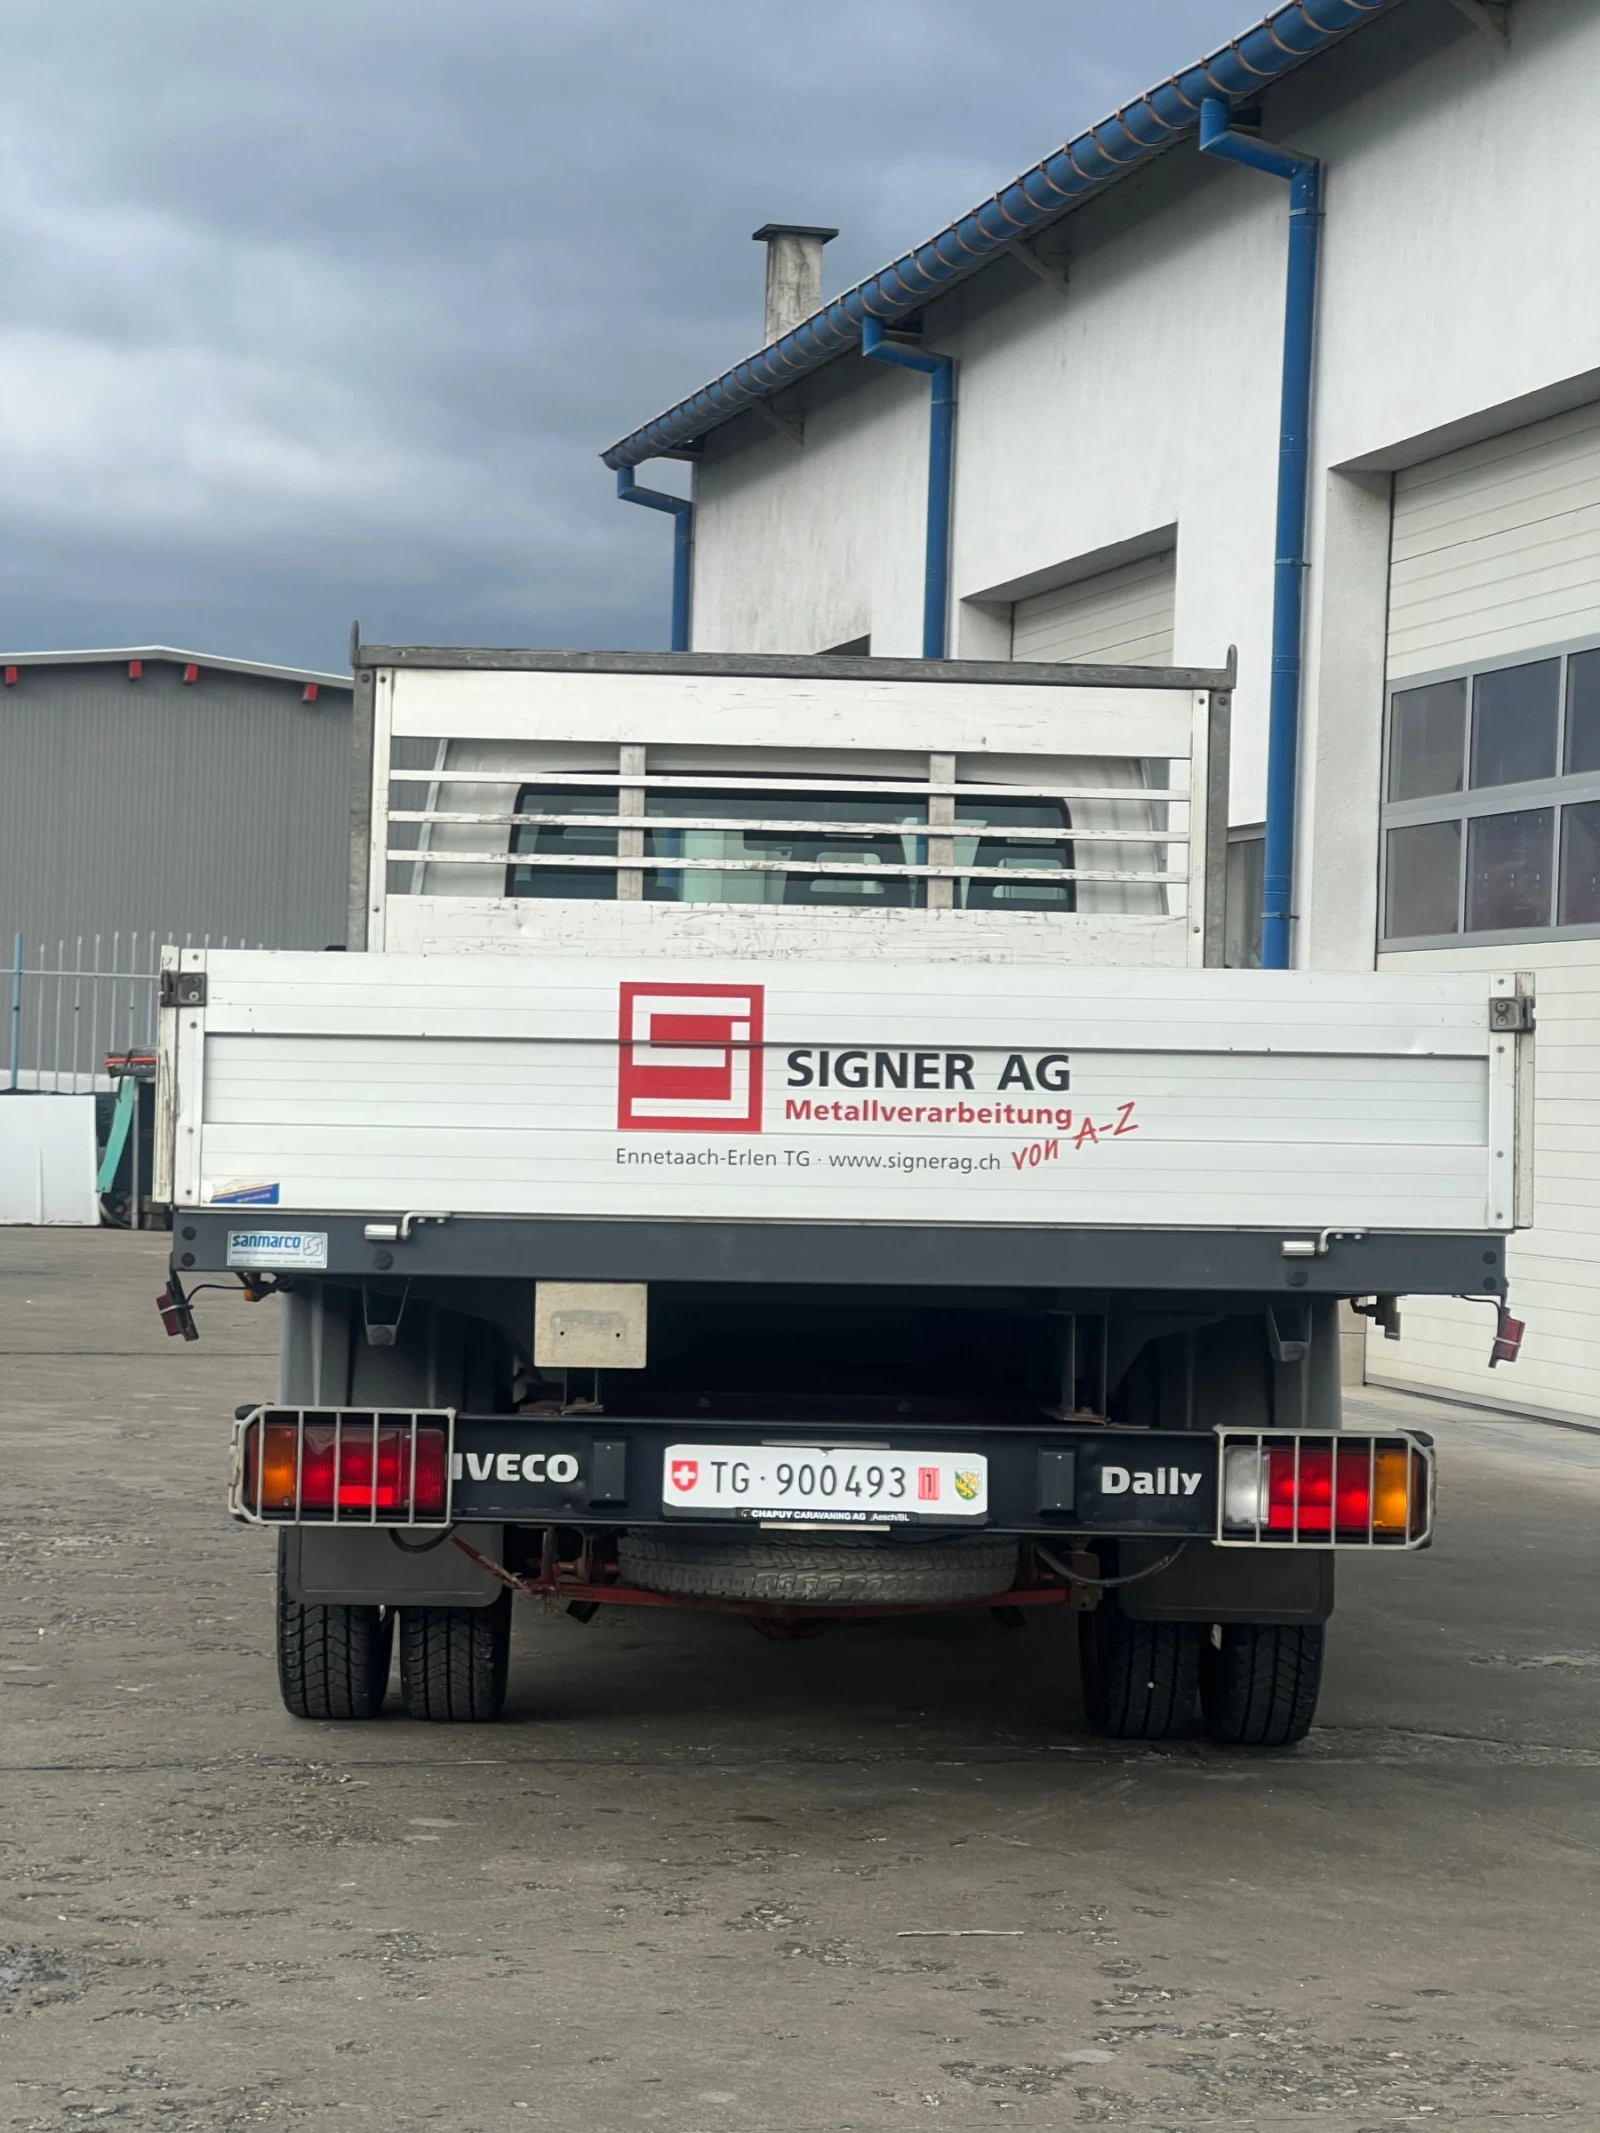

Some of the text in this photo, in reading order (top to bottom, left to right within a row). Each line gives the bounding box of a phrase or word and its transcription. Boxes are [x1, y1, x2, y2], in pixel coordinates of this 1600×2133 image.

[787, 1050, 1071, 1092] SIGNER AG
[785, 1100, 1073, 1131] Metallverarbeitung
[1012, 1101, 1139, 1172] von A-Z
[616, 1149, 1001, 1174] Ennetaach-Erlen TG www.signerag.ch
[232, 1235, 301, 1248] sanmarco
[452, 1453, 579, 1482] IVECO
[1102, 1467, 1202, 1494] Daily
[751, 1510, 793, 1519] CHAPUY
[795, 1511, 851, 1520] CARAVANING
[853, 1513, 867, 1521] AG
